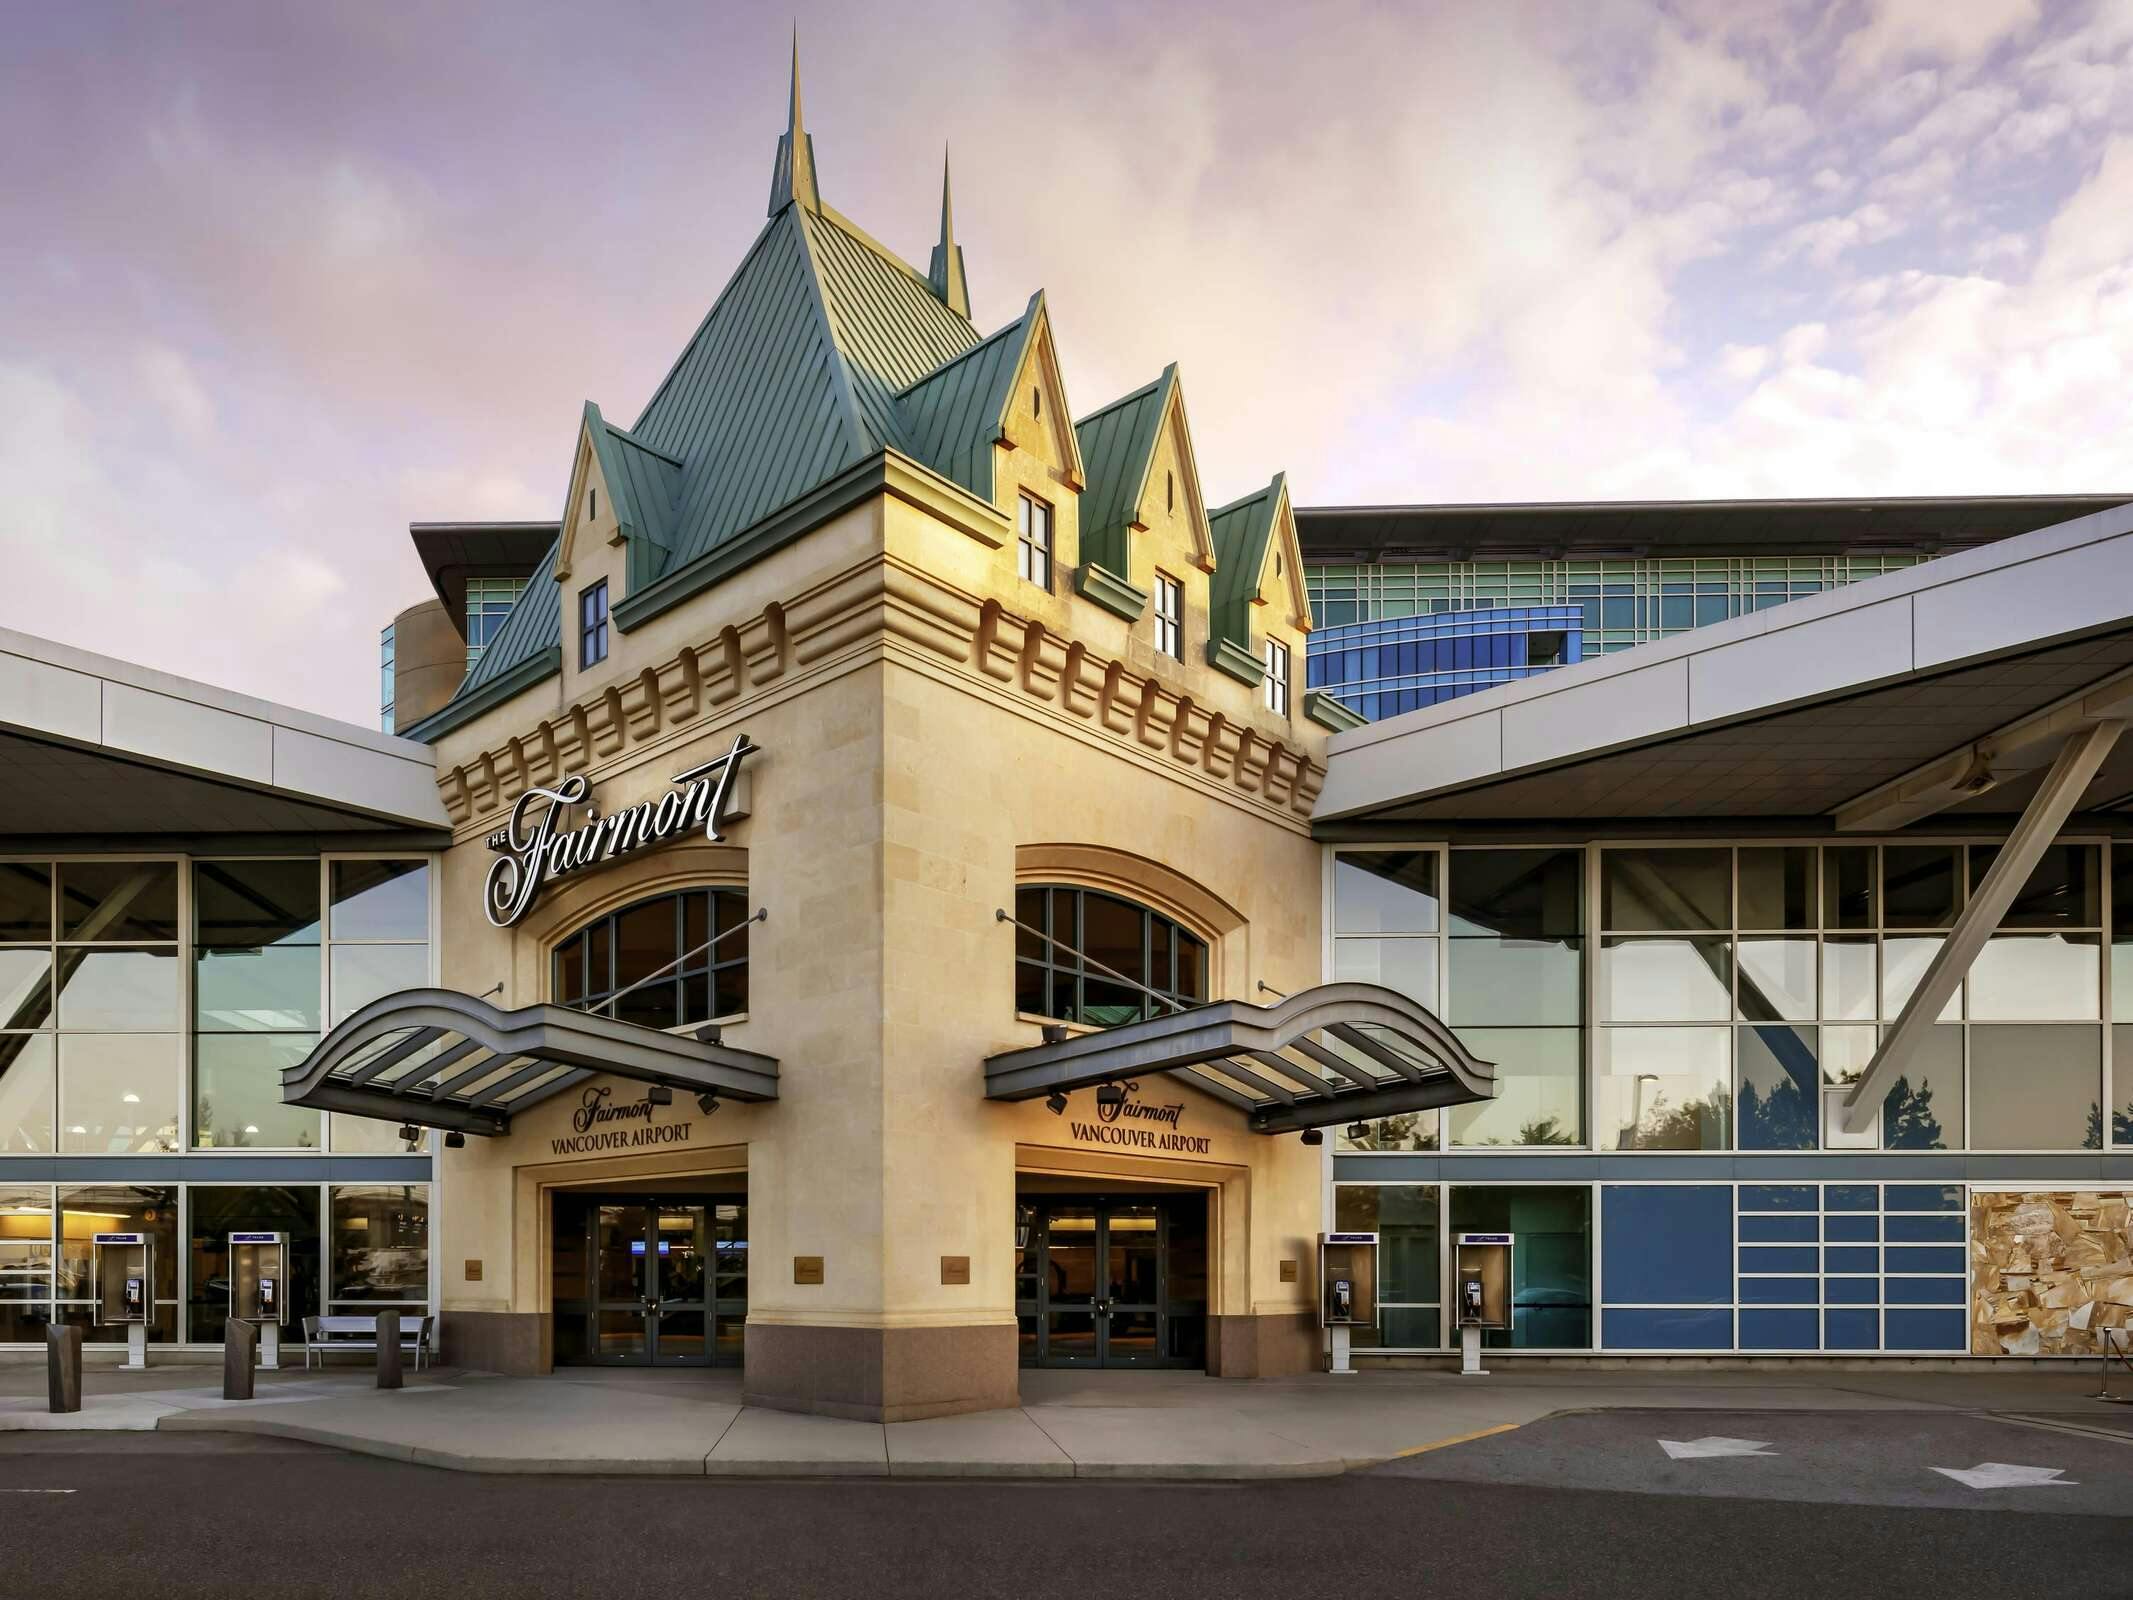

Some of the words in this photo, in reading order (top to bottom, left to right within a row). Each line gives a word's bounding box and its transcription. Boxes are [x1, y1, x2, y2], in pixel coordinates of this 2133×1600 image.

[483, 733, 760, 928] Fairmont
[485, 830, 507, 850] THE
[1097, 1079, 1185, 1131] Fairmont
[551, 1130, 630, 1155] VANCOUVER
[631, 1122, 693, 1147] AIRPORT
[1071, 1121, 1157, 1149] VANCOUVER
[1158, 1132, 1212, 1154] AIRPORT
